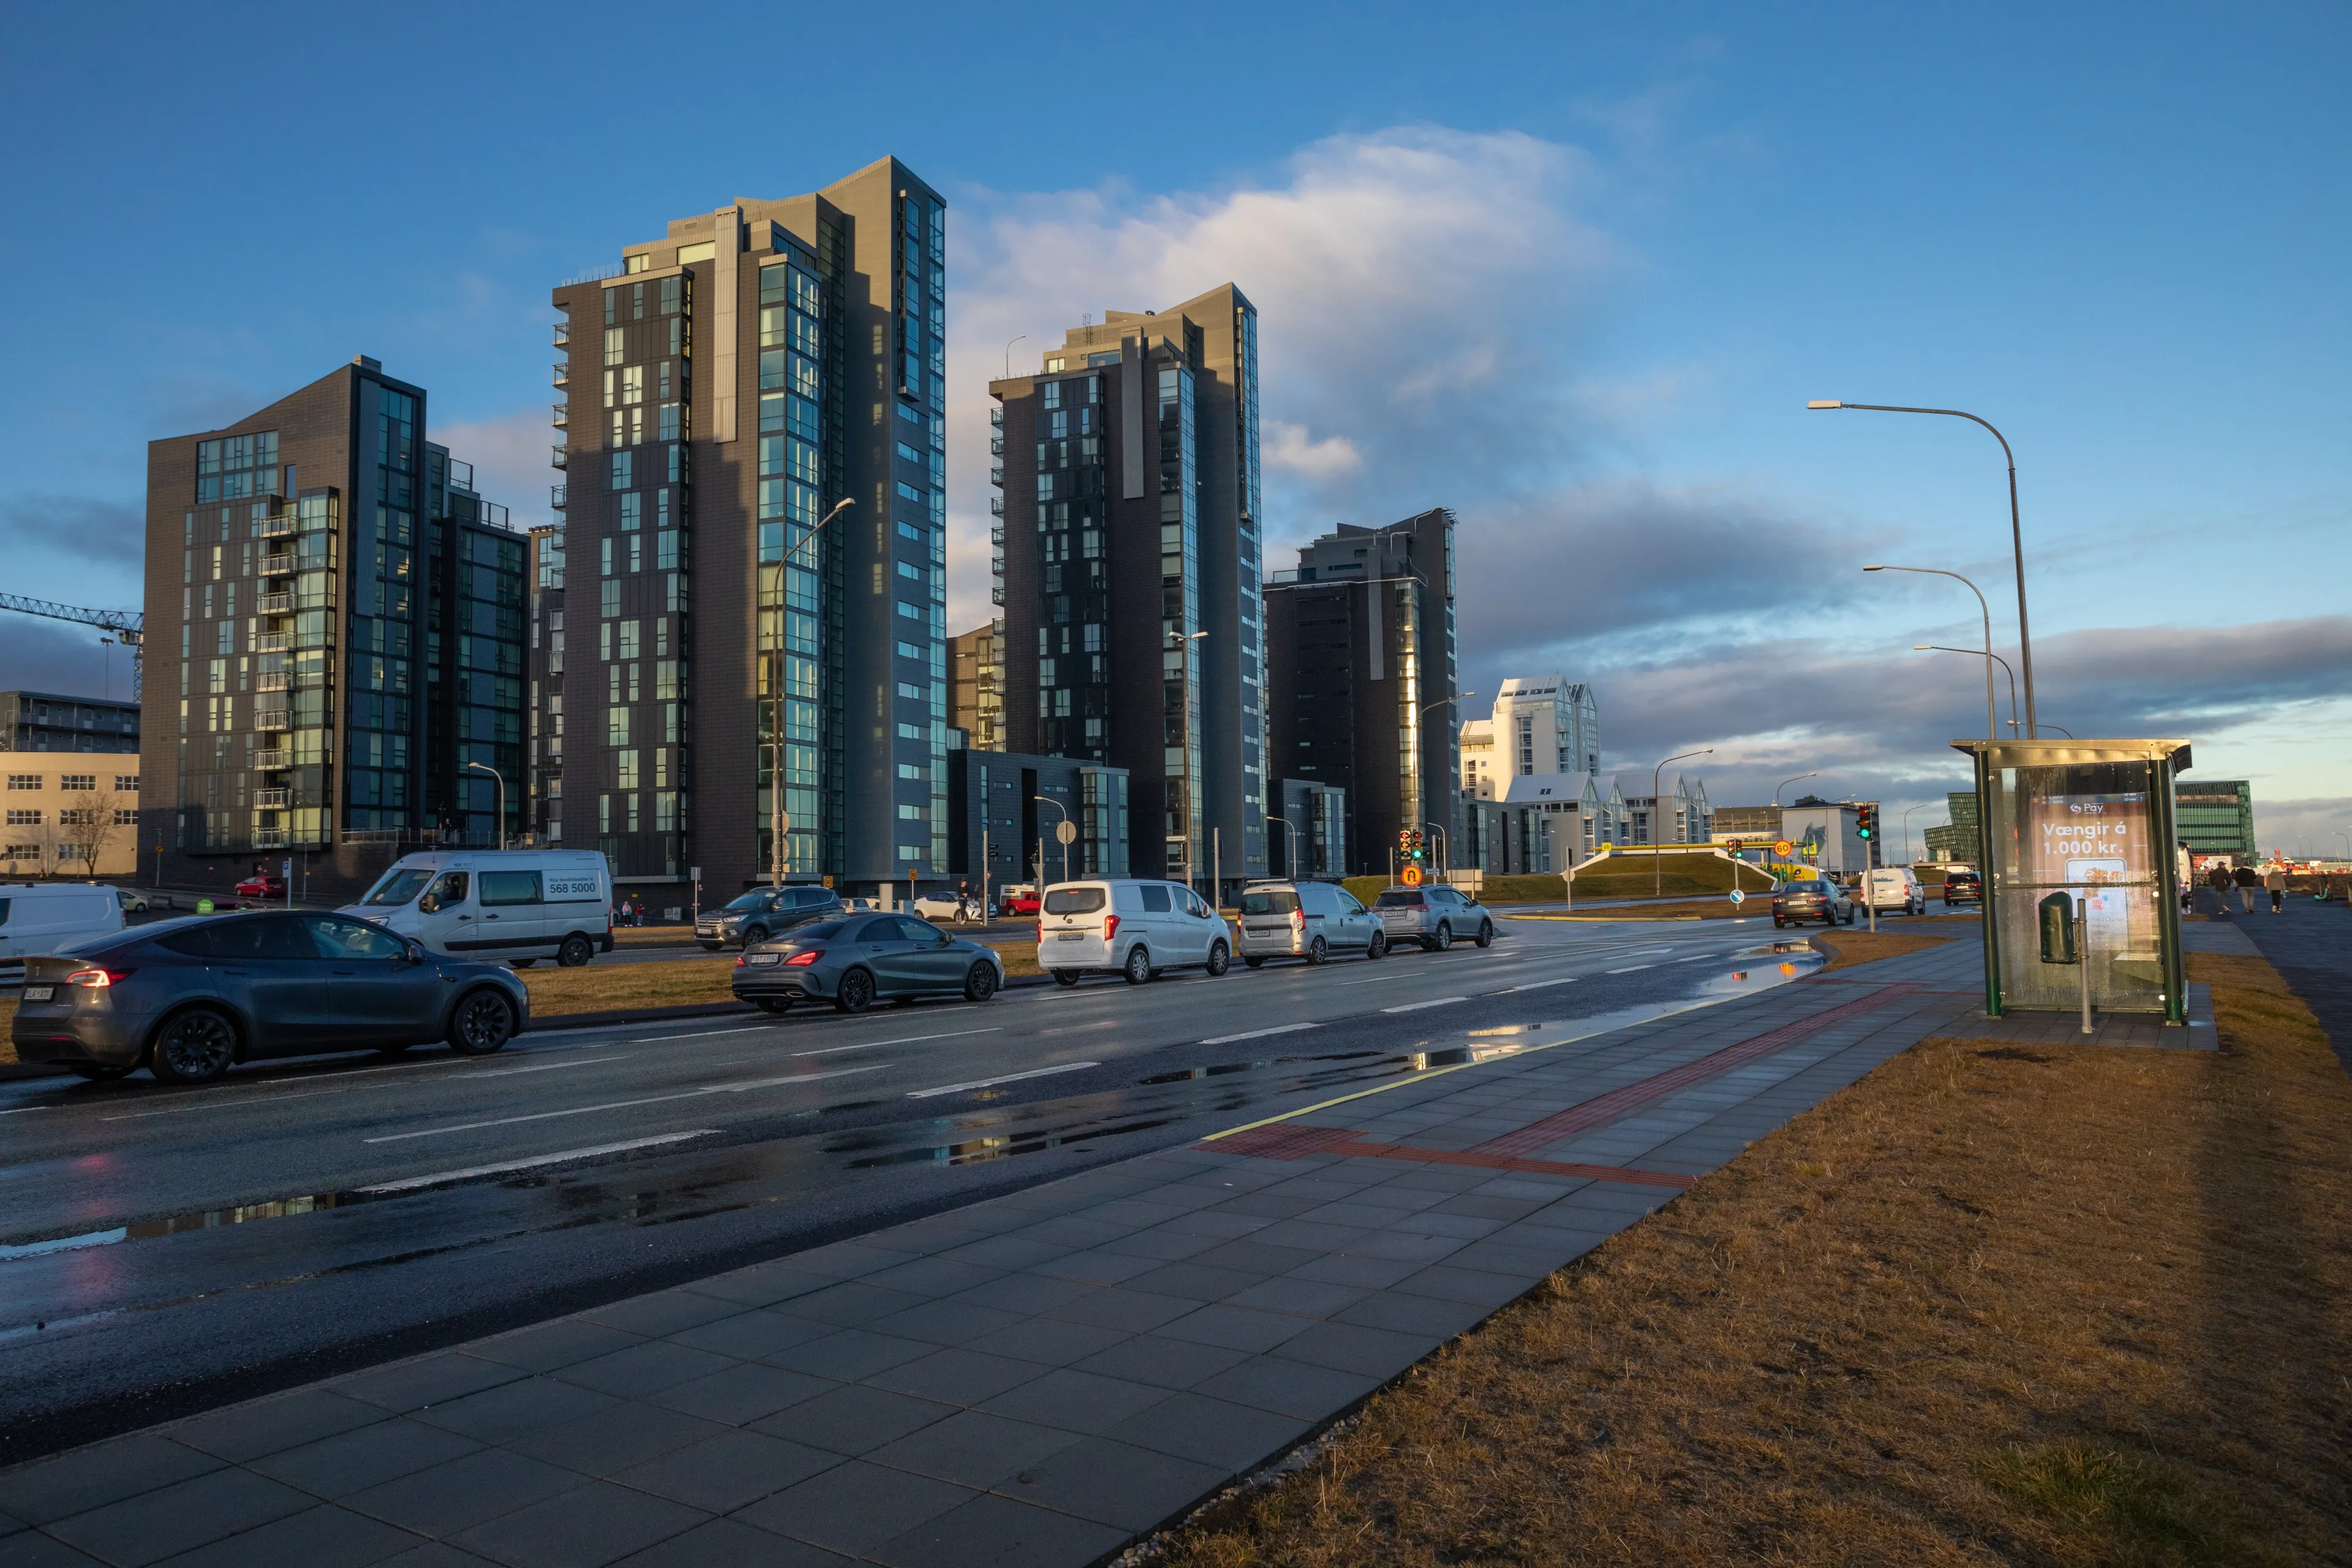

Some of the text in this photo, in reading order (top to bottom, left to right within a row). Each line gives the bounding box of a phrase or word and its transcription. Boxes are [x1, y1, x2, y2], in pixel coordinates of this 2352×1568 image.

[2084, 803, 2103, 813] Pay
[2042, 821, 2126, 839] Vængir á
[2044, 840, 2124, 854] 1.000 kr.
[550, 883, 595, 893] 568 5000
